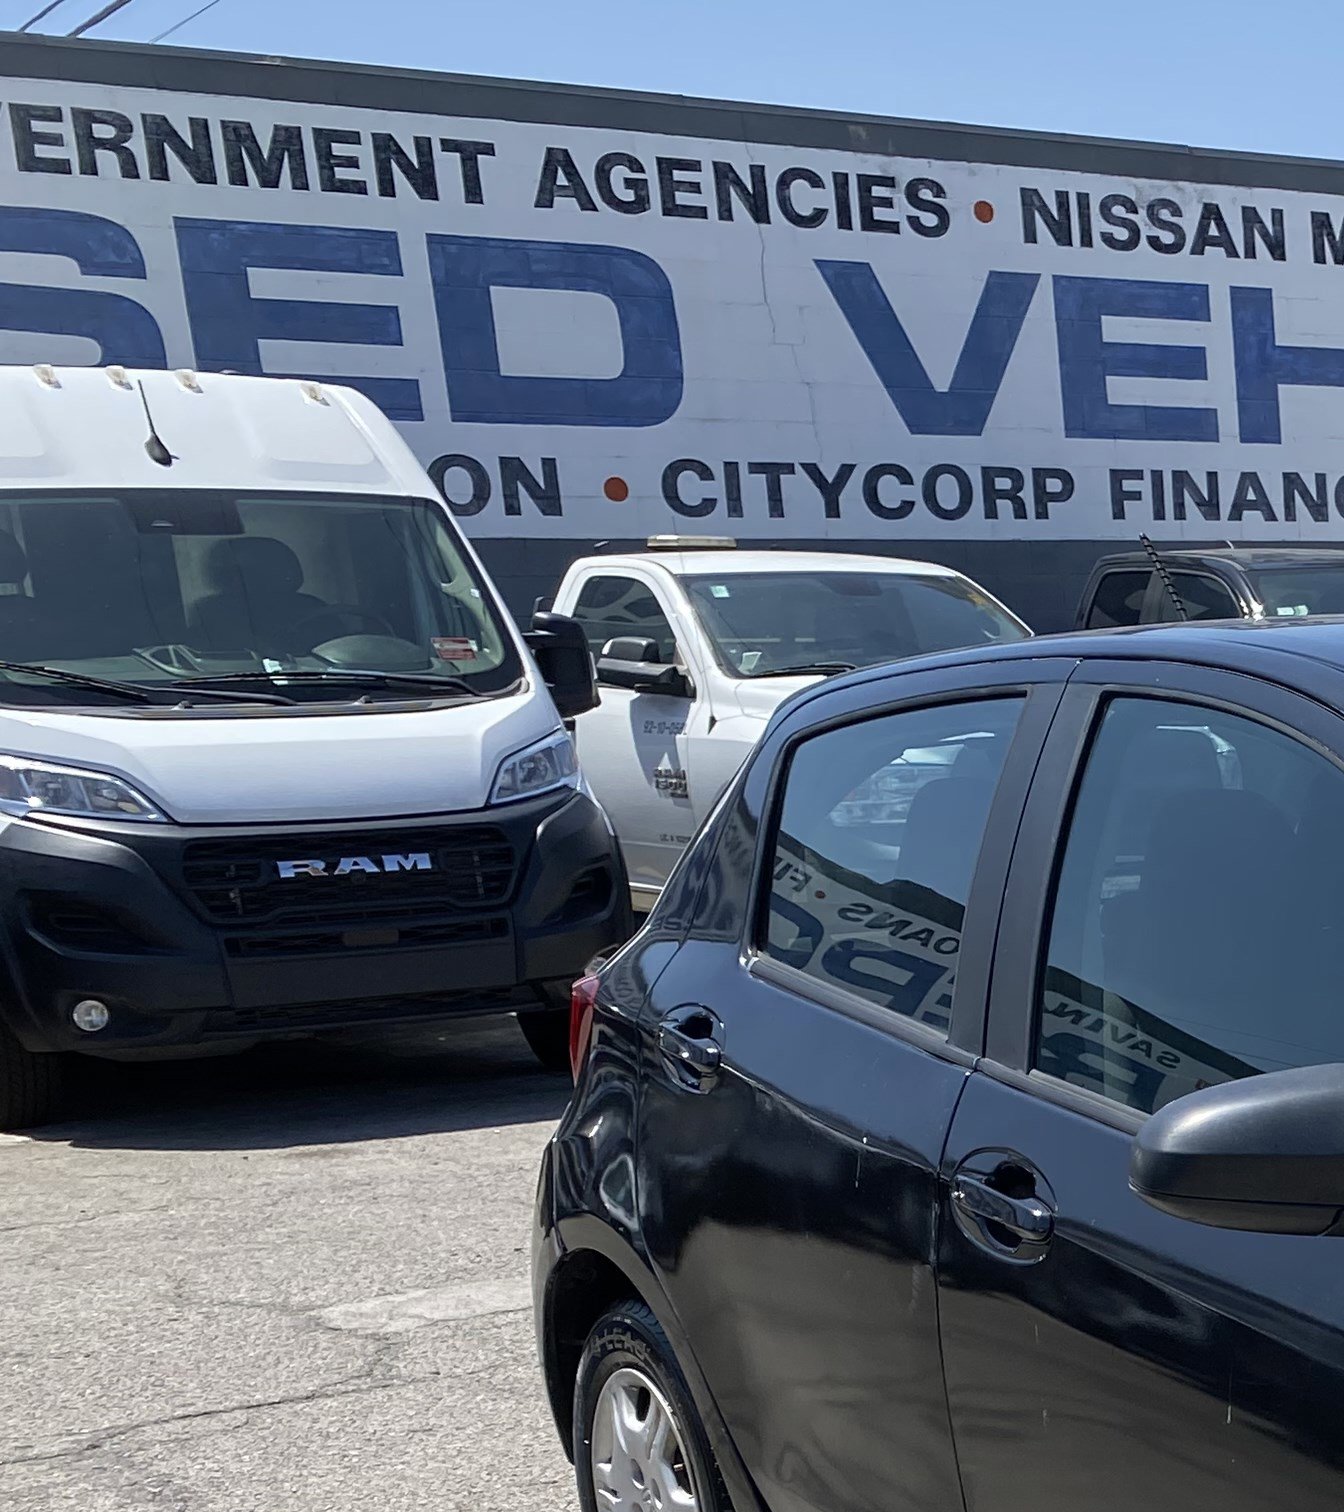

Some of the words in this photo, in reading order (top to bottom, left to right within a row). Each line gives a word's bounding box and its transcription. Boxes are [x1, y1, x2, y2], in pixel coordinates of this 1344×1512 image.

[0, 101, 496, 204] ERNMENT
[534, 147, 950, 238] AGENCIES
[1021, 187, 1286, 261] NISSAN
[661, 458, 1075, 523] CITYCORP
[277, 853, 432, 879] RAM
